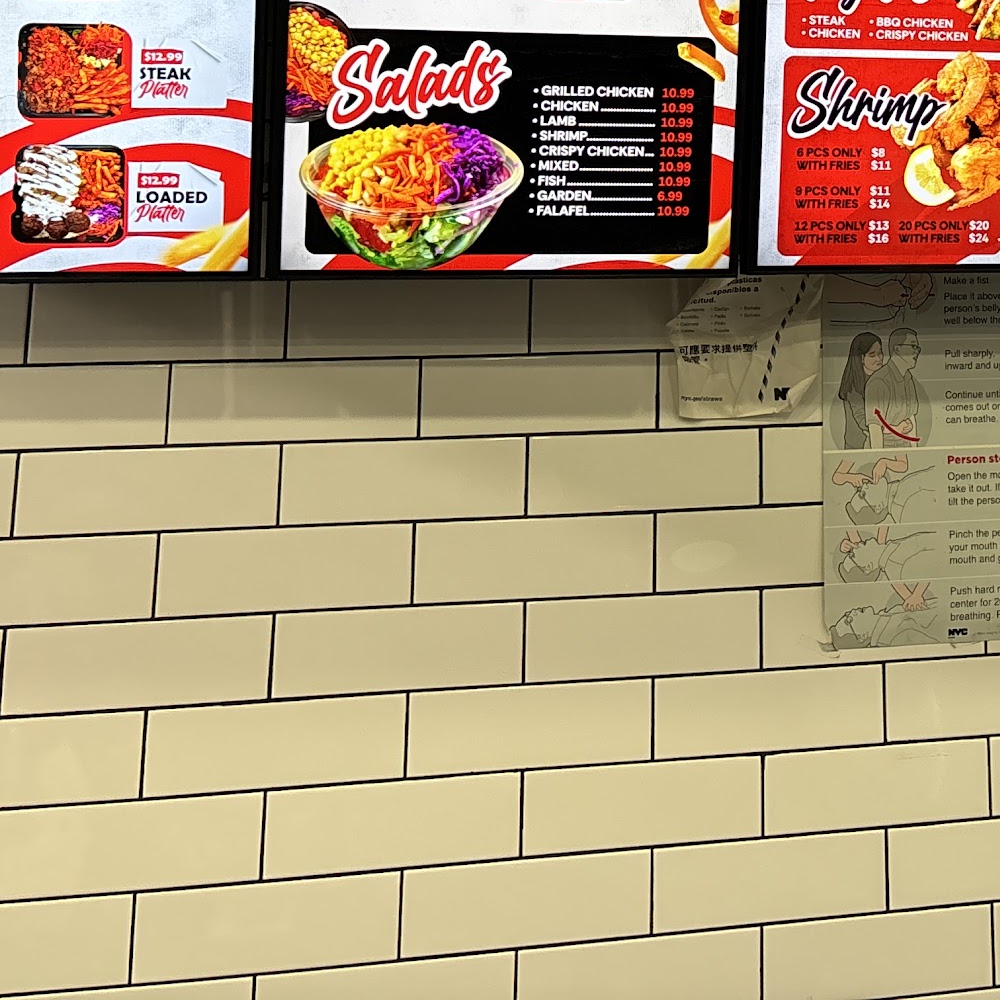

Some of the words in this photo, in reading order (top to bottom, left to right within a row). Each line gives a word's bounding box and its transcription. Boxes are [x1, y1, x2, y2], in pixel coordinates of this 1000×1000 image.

[809, 15, 846, 27] STEAK
[876, 16, 901, 28] BBQ
[903, 17, 953, 29] CHICKEN
[876, 30, 916, 42] CRISPY
[918, 30, 968, 43] CHICKEN
[330, 42, 509, 128] Salads
[541, 85, 594, 98] GRILLED
[596, 86, 654, 98] CHICKEN
[662, 88, 694, 99] 10.99
[789, 66, 948, 143] Shrimp
[539, 146, 584, 158] CRISPY
[660, 147, 692, 158] 10.99
[797, 160, 826, 171] WITH
[829, 161, 860, 171] FRIES
[870, 160, 891, 171] $11
[141, 174, 178, 186] $12.99
[136, 190, 207, 204] LOADED
[657, 191, 682, 202] 6.99
[945, 390, 983, 399] Continue
[947, 455, 986, 464] Person
[949, 530, 973, 539] Pinch
[976, 529, 989, 538] the
[948, 628, 968, 636] NYC
